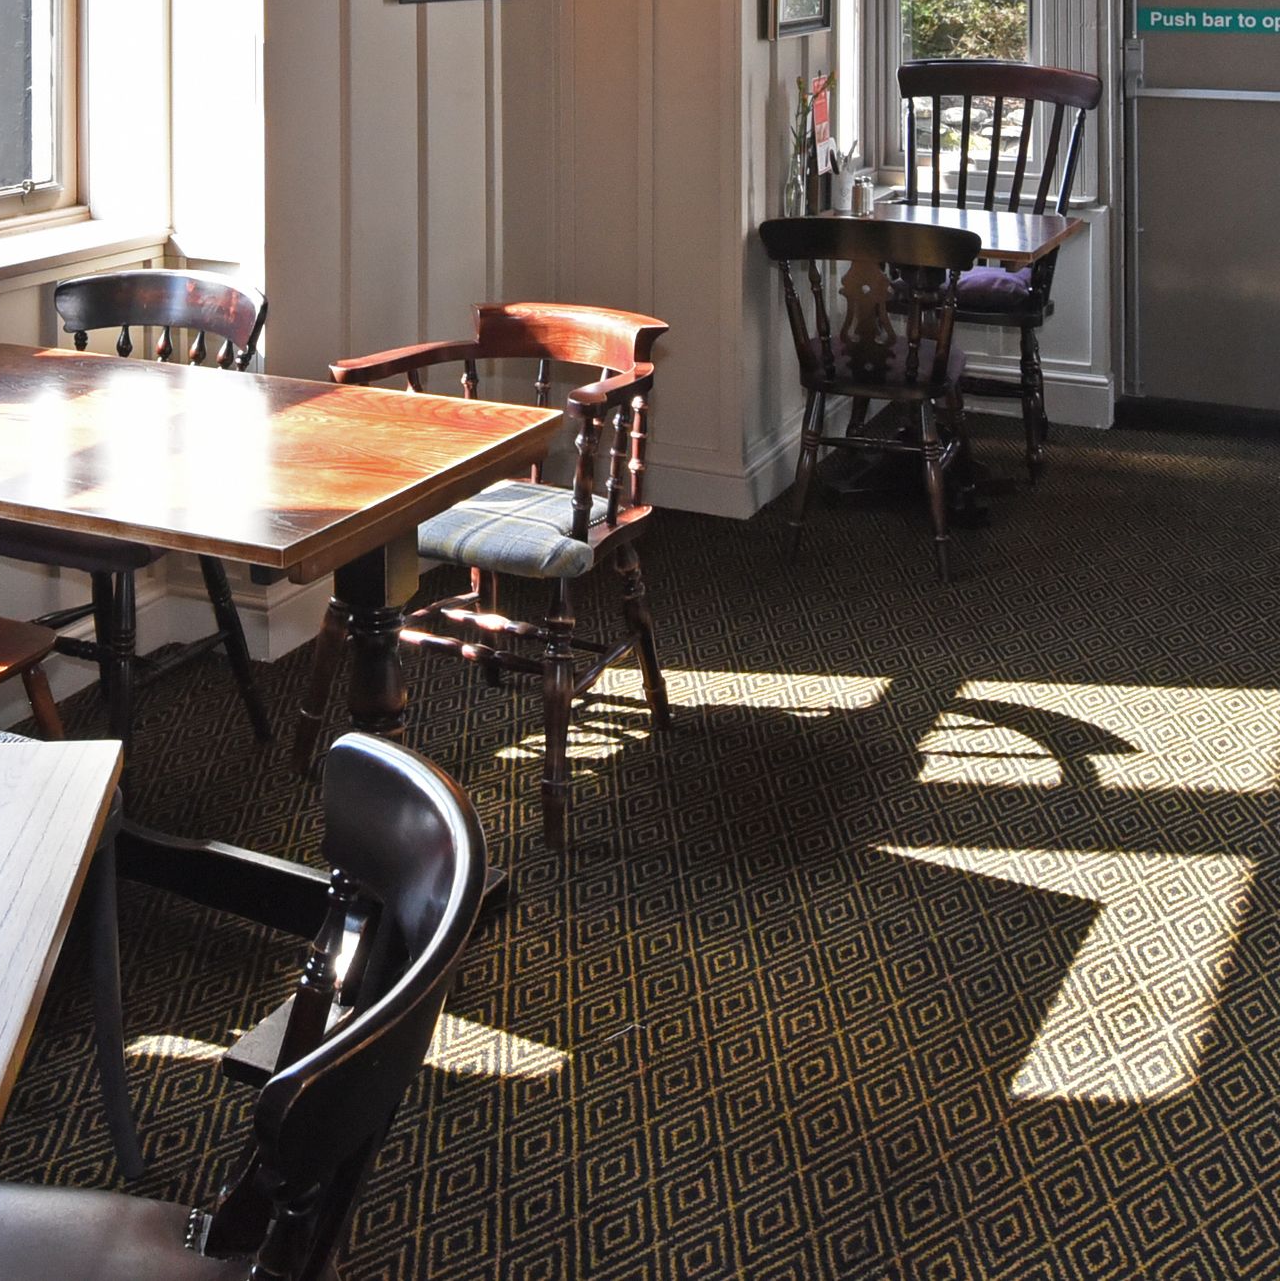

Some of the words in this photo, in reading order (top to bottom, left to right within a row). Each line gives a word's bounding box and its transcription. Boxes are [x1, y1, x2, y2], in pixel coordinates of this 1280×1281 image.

[1150, 11, 1196, 27] Push
[1202, 12, 1233, 27] bar
[1238, 13, 1257, 28] to
